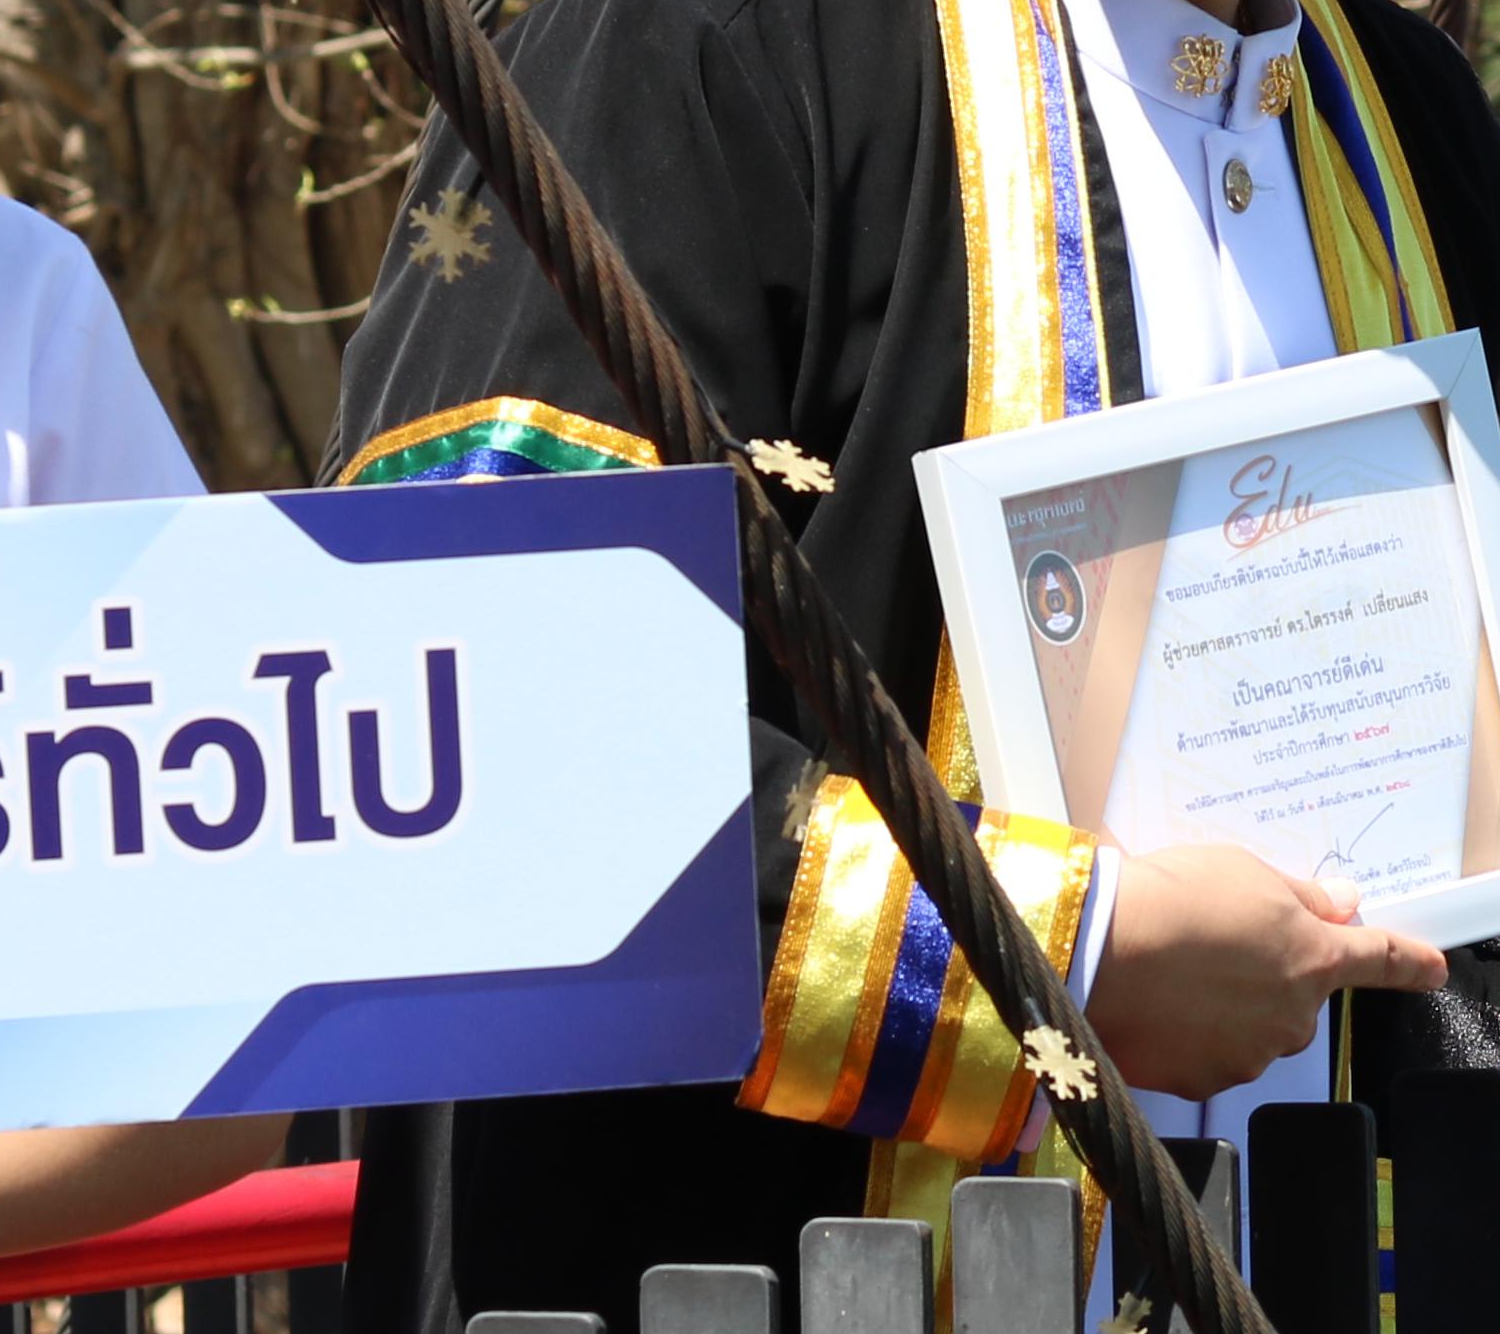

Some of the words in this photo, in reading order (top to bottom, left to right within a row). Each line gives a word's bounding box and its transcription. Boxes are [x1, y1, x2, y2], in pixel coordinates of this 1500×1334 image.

[1223, 454, 1313, 549] Edu
[1163, 618, 1283, 669] ผู้ช่วยศาสตราจารย์
[1232, 652, 1384, 707] เป็นคณาจารย์ดีเด่น
